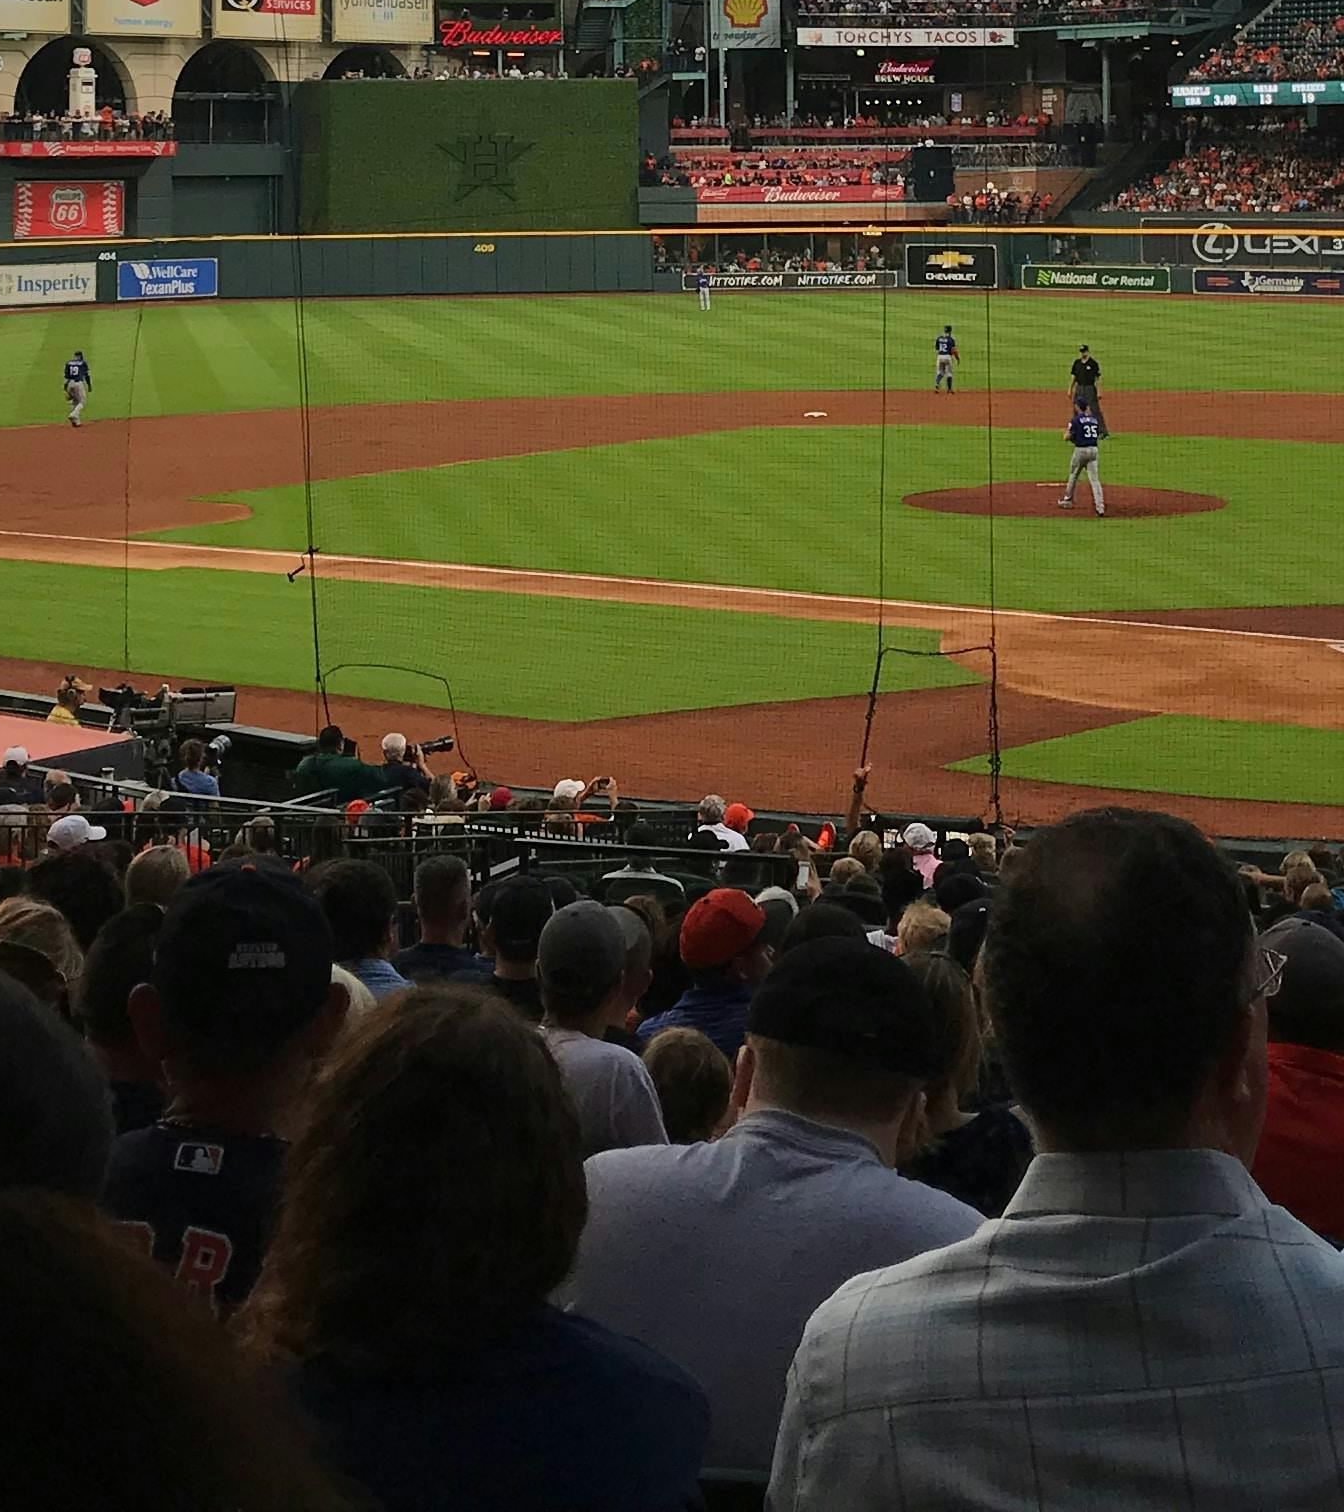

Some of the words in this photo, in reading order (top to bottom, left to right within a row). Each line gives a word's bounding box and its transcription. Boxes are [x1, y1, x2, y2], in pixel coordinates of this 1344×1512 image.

[439, 19, 563, 47] Budweiser
[835, 31, 912, 43] TORCHYS
[926, 31, 977, 44] TACOS
[761, 186, 840, 202] Budweiser
[57, 206, 79, 221] 66
[98, 252, 116, 261] 404
[151, 264, 198, 279] WellCare
[925, 271, 977, 282] CHEVROLET
[1050, 271, 1097, 285] National
[1101, 274, 1120, 285] Car
[1123, 275, 1155, 287] Rental
[16, 272, 90, 296] Insperity
[798, 274, 876, 286] NITTOTIRE.COM
[140, 280, 195, 296] TexanPlus
[1084, 425, 1098, 438] 35
